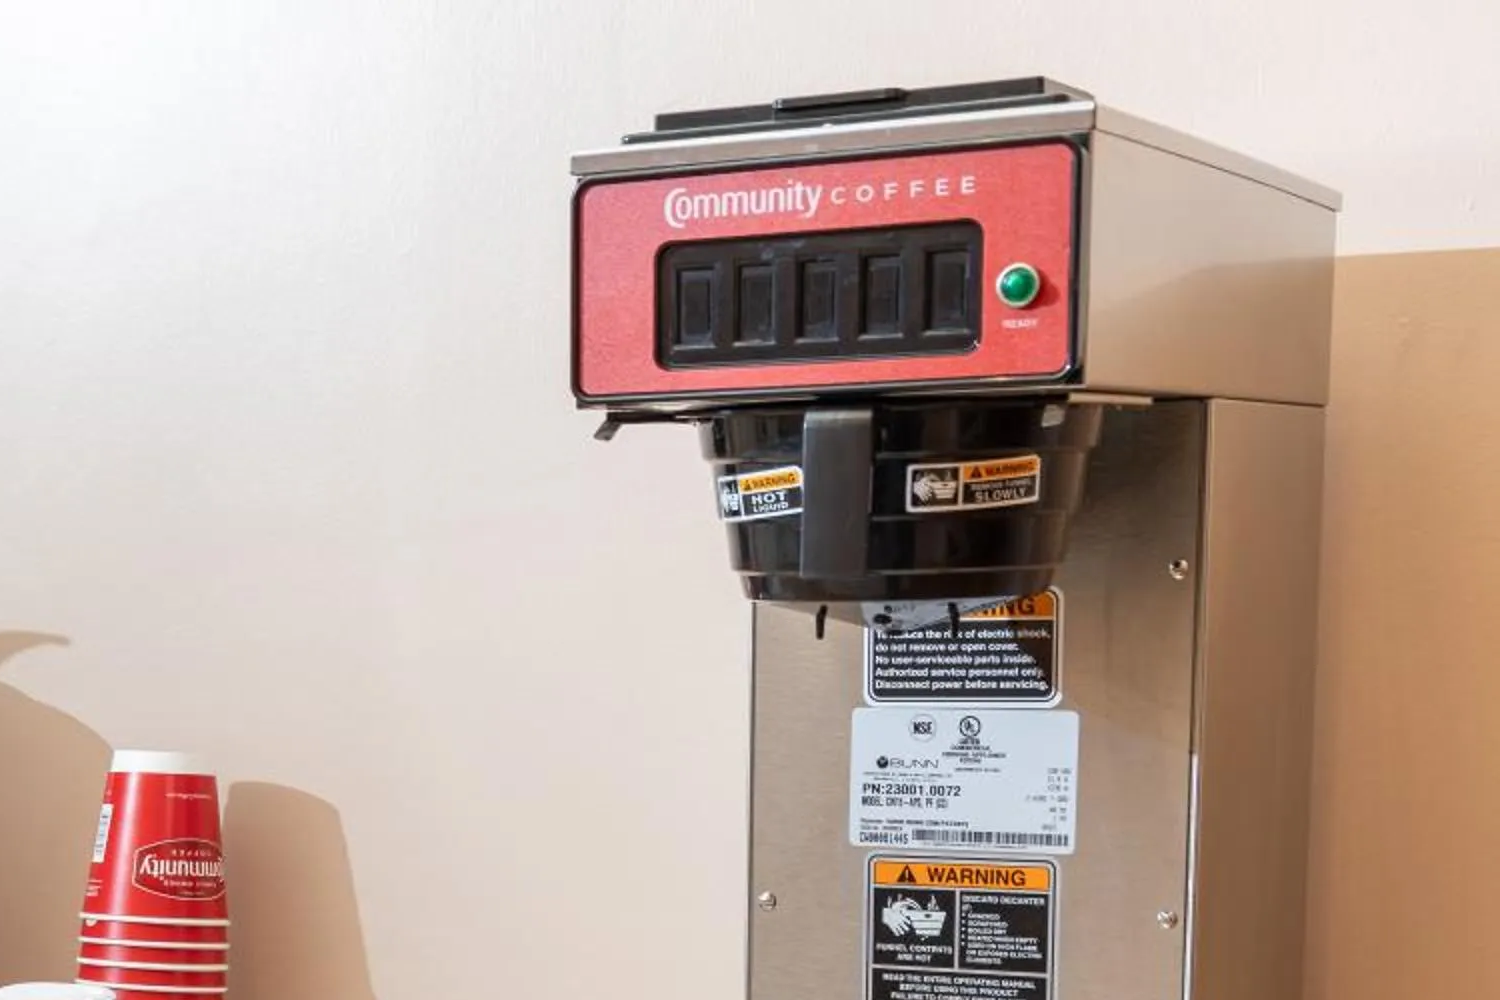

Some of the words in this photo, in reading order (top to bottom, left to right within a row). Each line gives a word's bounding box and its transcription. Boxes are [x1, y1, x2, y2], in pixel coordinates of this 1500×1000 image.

[664, 179, 823, 229] Community
[830, 175, 977, 206] COFFEE
[984, 461, 1034, 477] WARNING
[752, 473, 796, 489] WARNING
[752, 491, 787, 504] HOT
[974, 487, 1027, 502] SLOWLY
[753, 501, 789, 513] LIQUID
[926, 630, 942, 639] the
[964, 630, 975, 639] of
[978, 630, 1014, 639] electric
[876, 643, 889, 652] do
[909, 644, 945, 652] remove
[947, 644, 959, 652] or
[960, 644, 986, 653] open
[876, 656, 889, 664] No
[974, 656, 1000, 666] parts
[875, 668, 928, 677] Authorized
[930, 668, 966, 677] service
[968, 668, 1018, 678] personnel
[875, 680, 930, 689] Disconnect
[932, 682, 963, 691] power
[965, 680, 996, 689] before
[999, 681, 1048, 690] servicing.
[890, 758, 939, 769] BUNN
[862, 783, 961, 797] PN:23001.0072
[927, 866, 1026, 887] WARNING
[923, 976, 951, 985] ENTIRE
[954, 978, 1000, 988] OPERATING
[934, 985, 958, 994] USING
